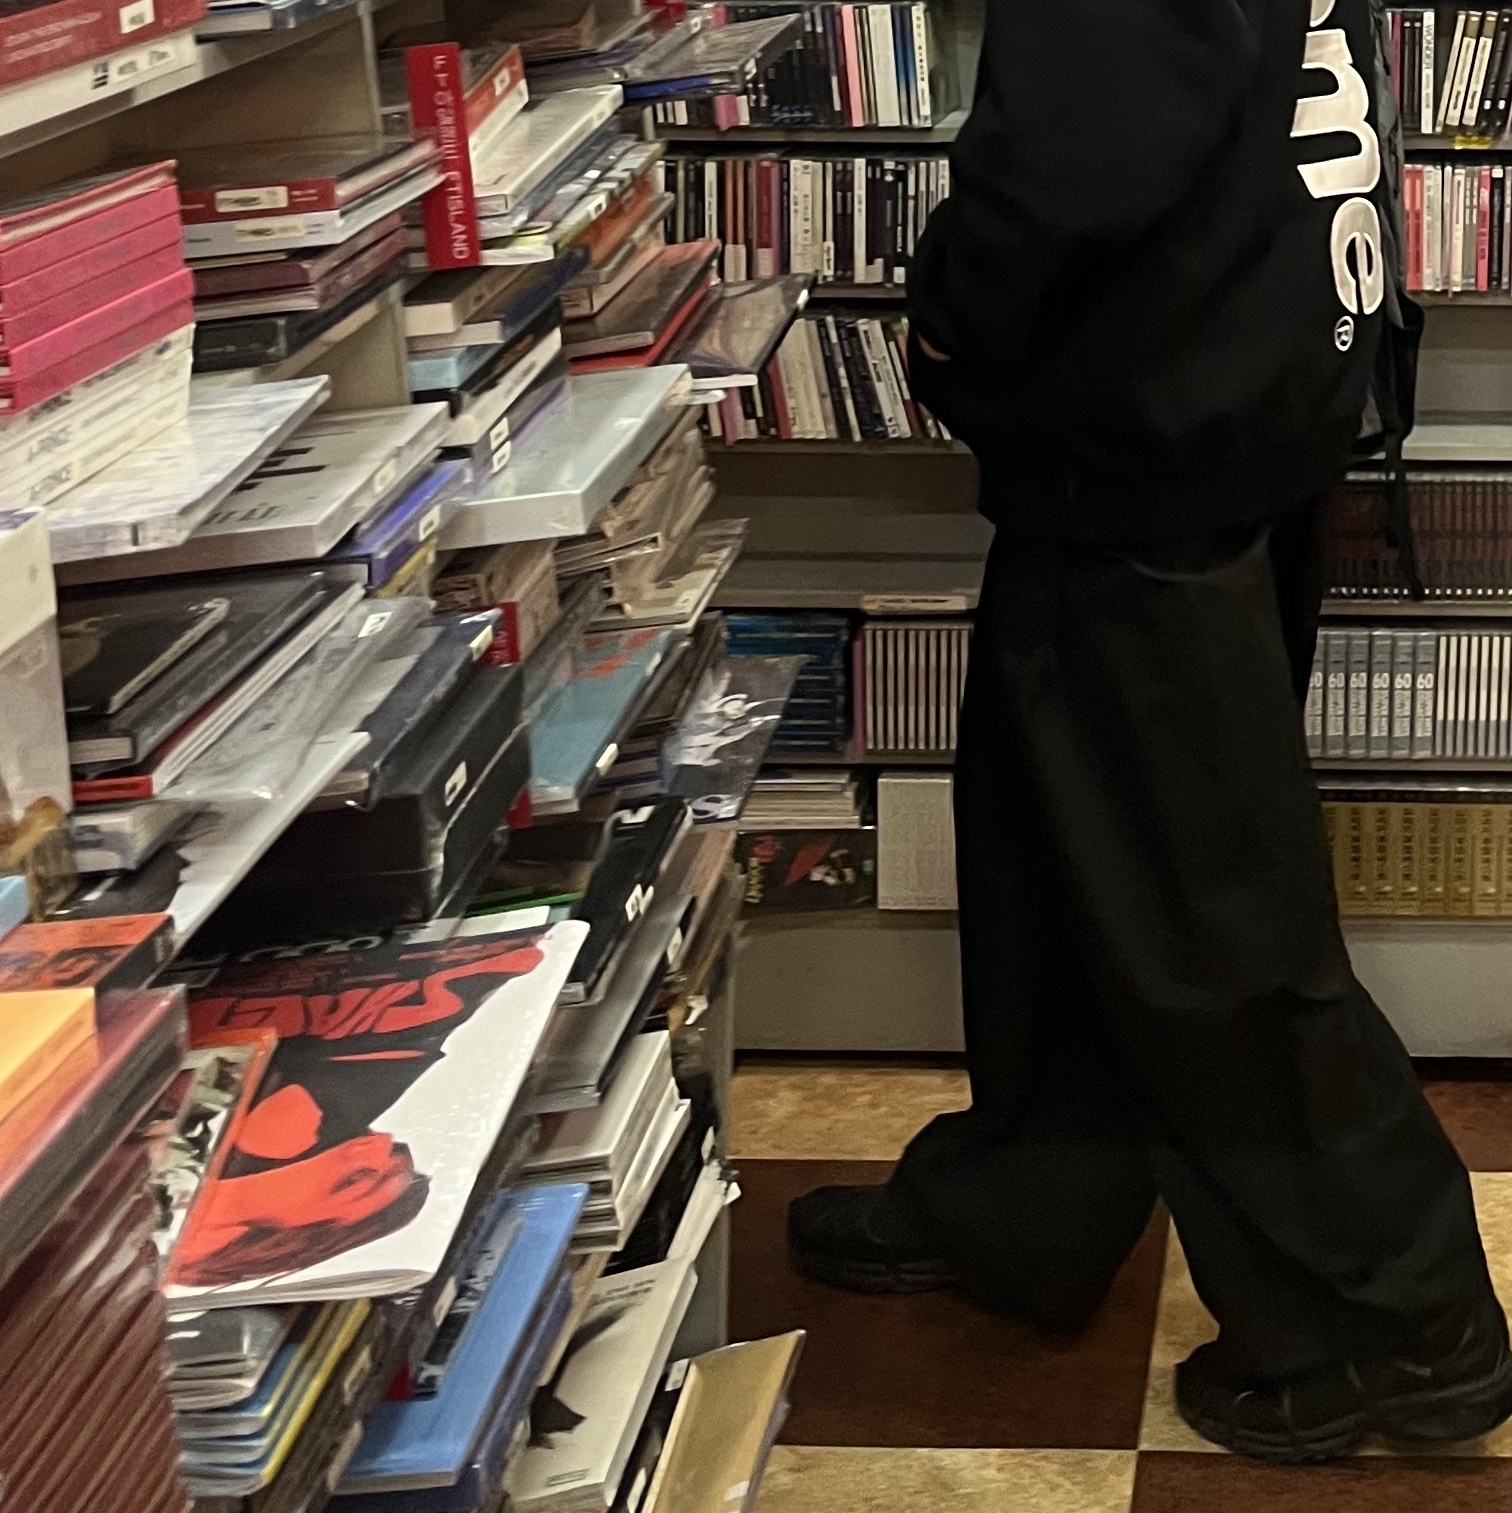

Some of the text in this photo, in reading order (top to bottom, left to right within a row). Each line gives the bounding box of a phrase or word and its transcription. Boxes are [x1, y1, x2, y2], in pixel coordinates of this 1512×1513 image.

[444, 171, 470, 260] FTISLAND
[1328, 672, 1345, 688] 60
[1349, 672, 1367, 688] 60
[1372, 672, 1390, 688] 60
[1394, 673, 1412, 689] 60
[1417, 673, 1435, 689] 60
